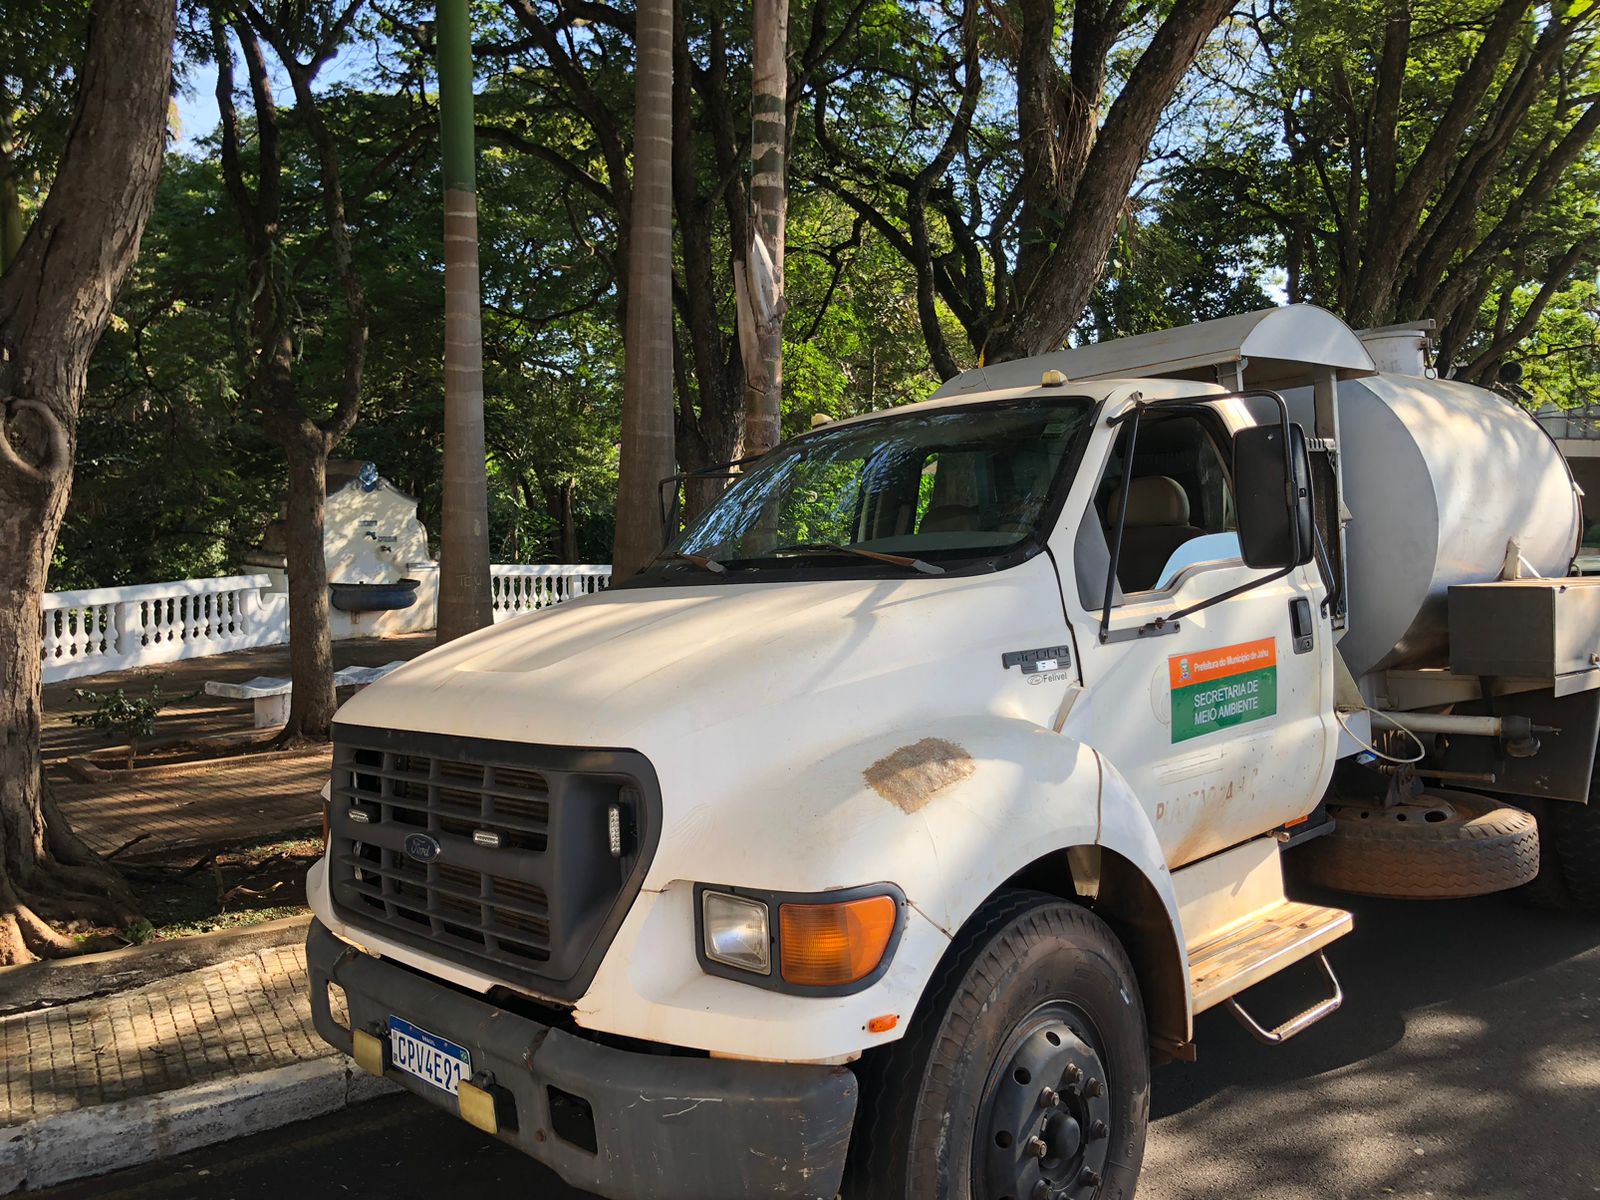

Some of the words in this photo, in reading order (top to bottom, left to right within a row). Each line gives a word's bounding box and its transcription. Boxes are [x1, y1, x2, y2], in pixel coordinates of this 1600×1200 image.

[1194, 661, 1219, 672] Prefeitura
[1257, 649, 1269, 658] Jahu
[1043, 672, 1068, 683] Felivel
[1194, 683, 1246, 707] SECRETARIA
[1247, 680, 1258, 693] DE
[1194, 708, 1217, 725] MEIO
[1218, 697, 1258, 717] AMBIENTE
[409, 837, 432, 858] Ford
